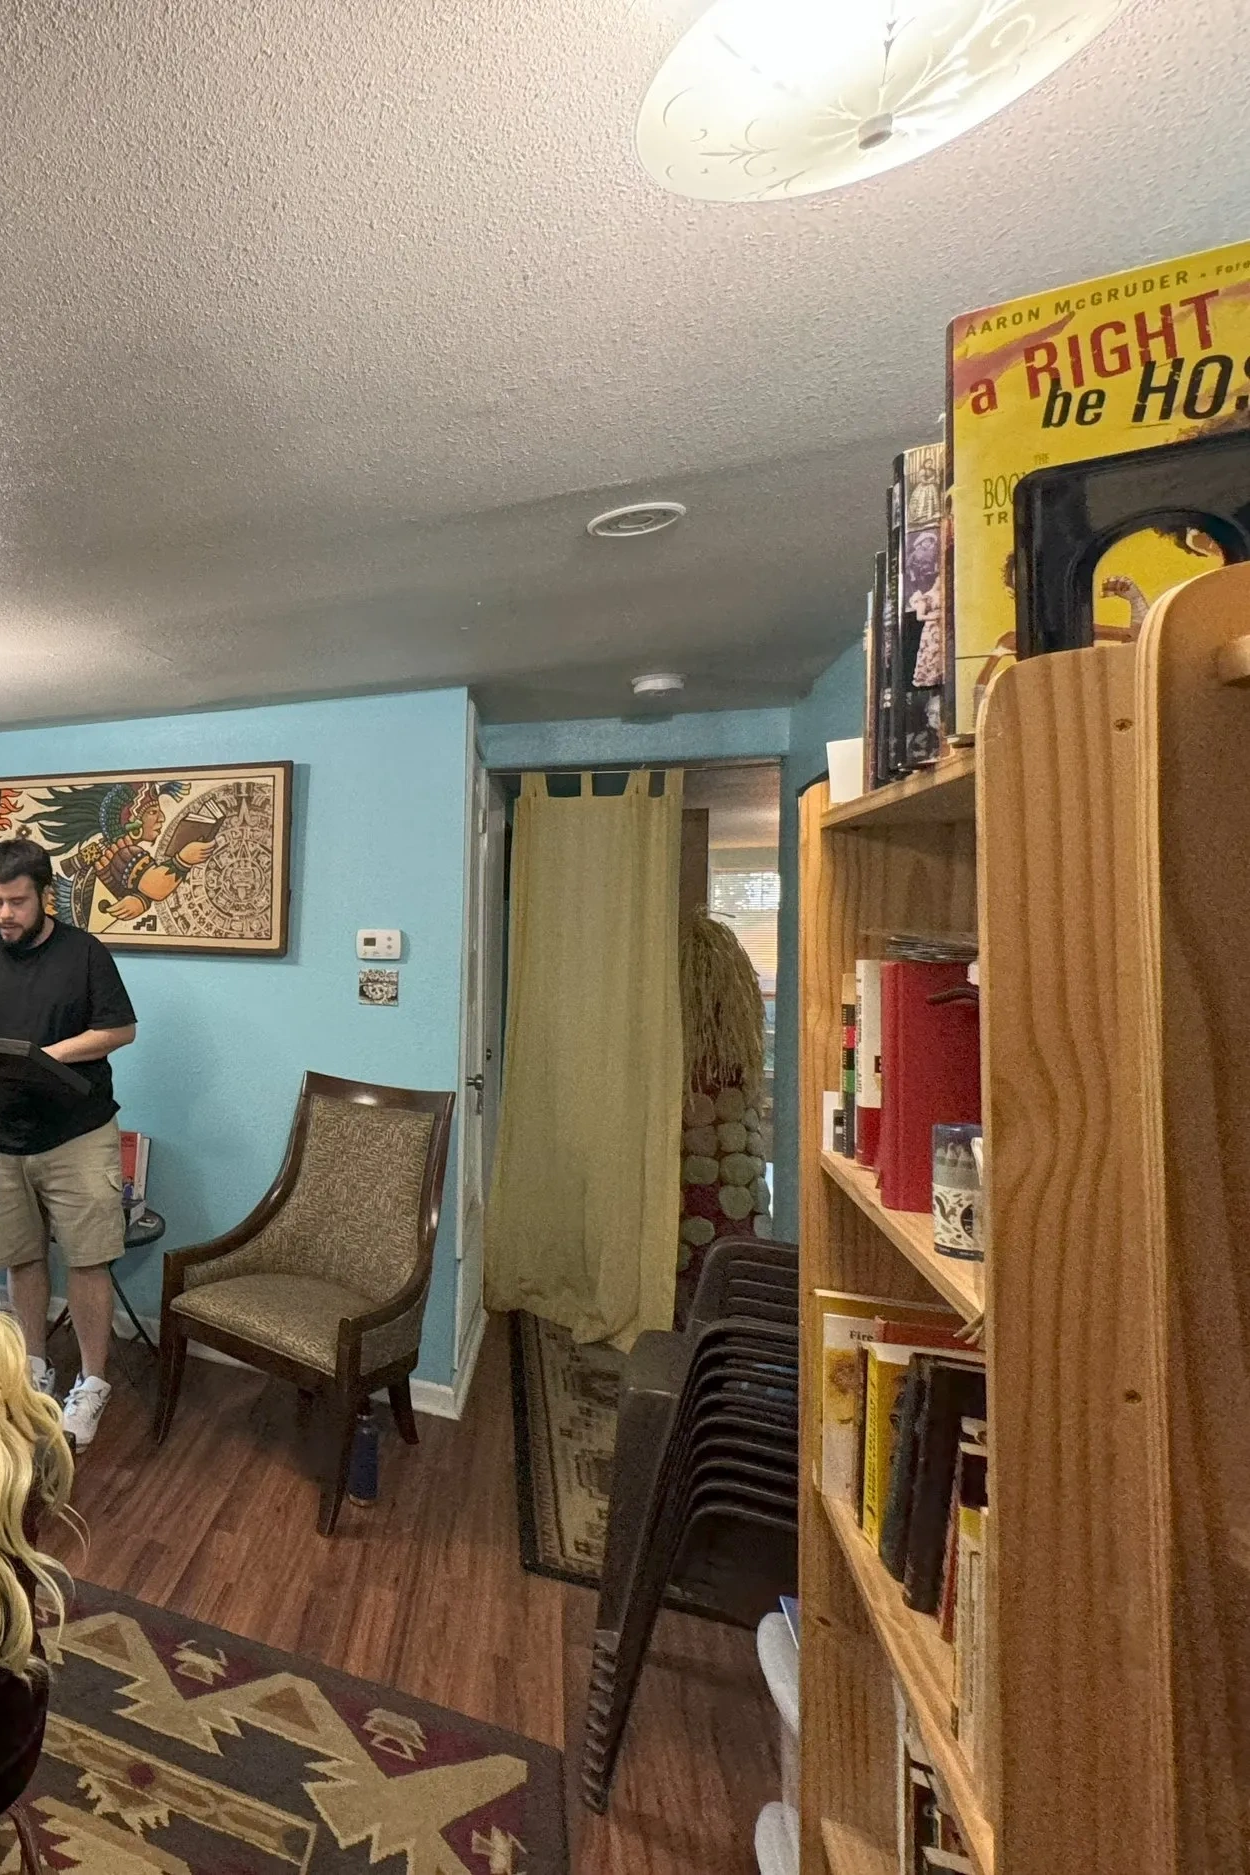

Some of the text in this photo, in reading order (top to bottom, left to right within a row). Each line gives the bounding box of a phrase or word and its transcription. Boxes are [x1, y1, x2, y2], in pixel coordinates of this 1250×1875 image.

[965, 307, 1040, 338] AARON
[1054, 270, 1188, 315] McGRUDER
[969, 289, 1219, 416] a RIGHT
[1041, 354, 1250, 428] be HO
[850, 1330, 874, 1342] Fire
